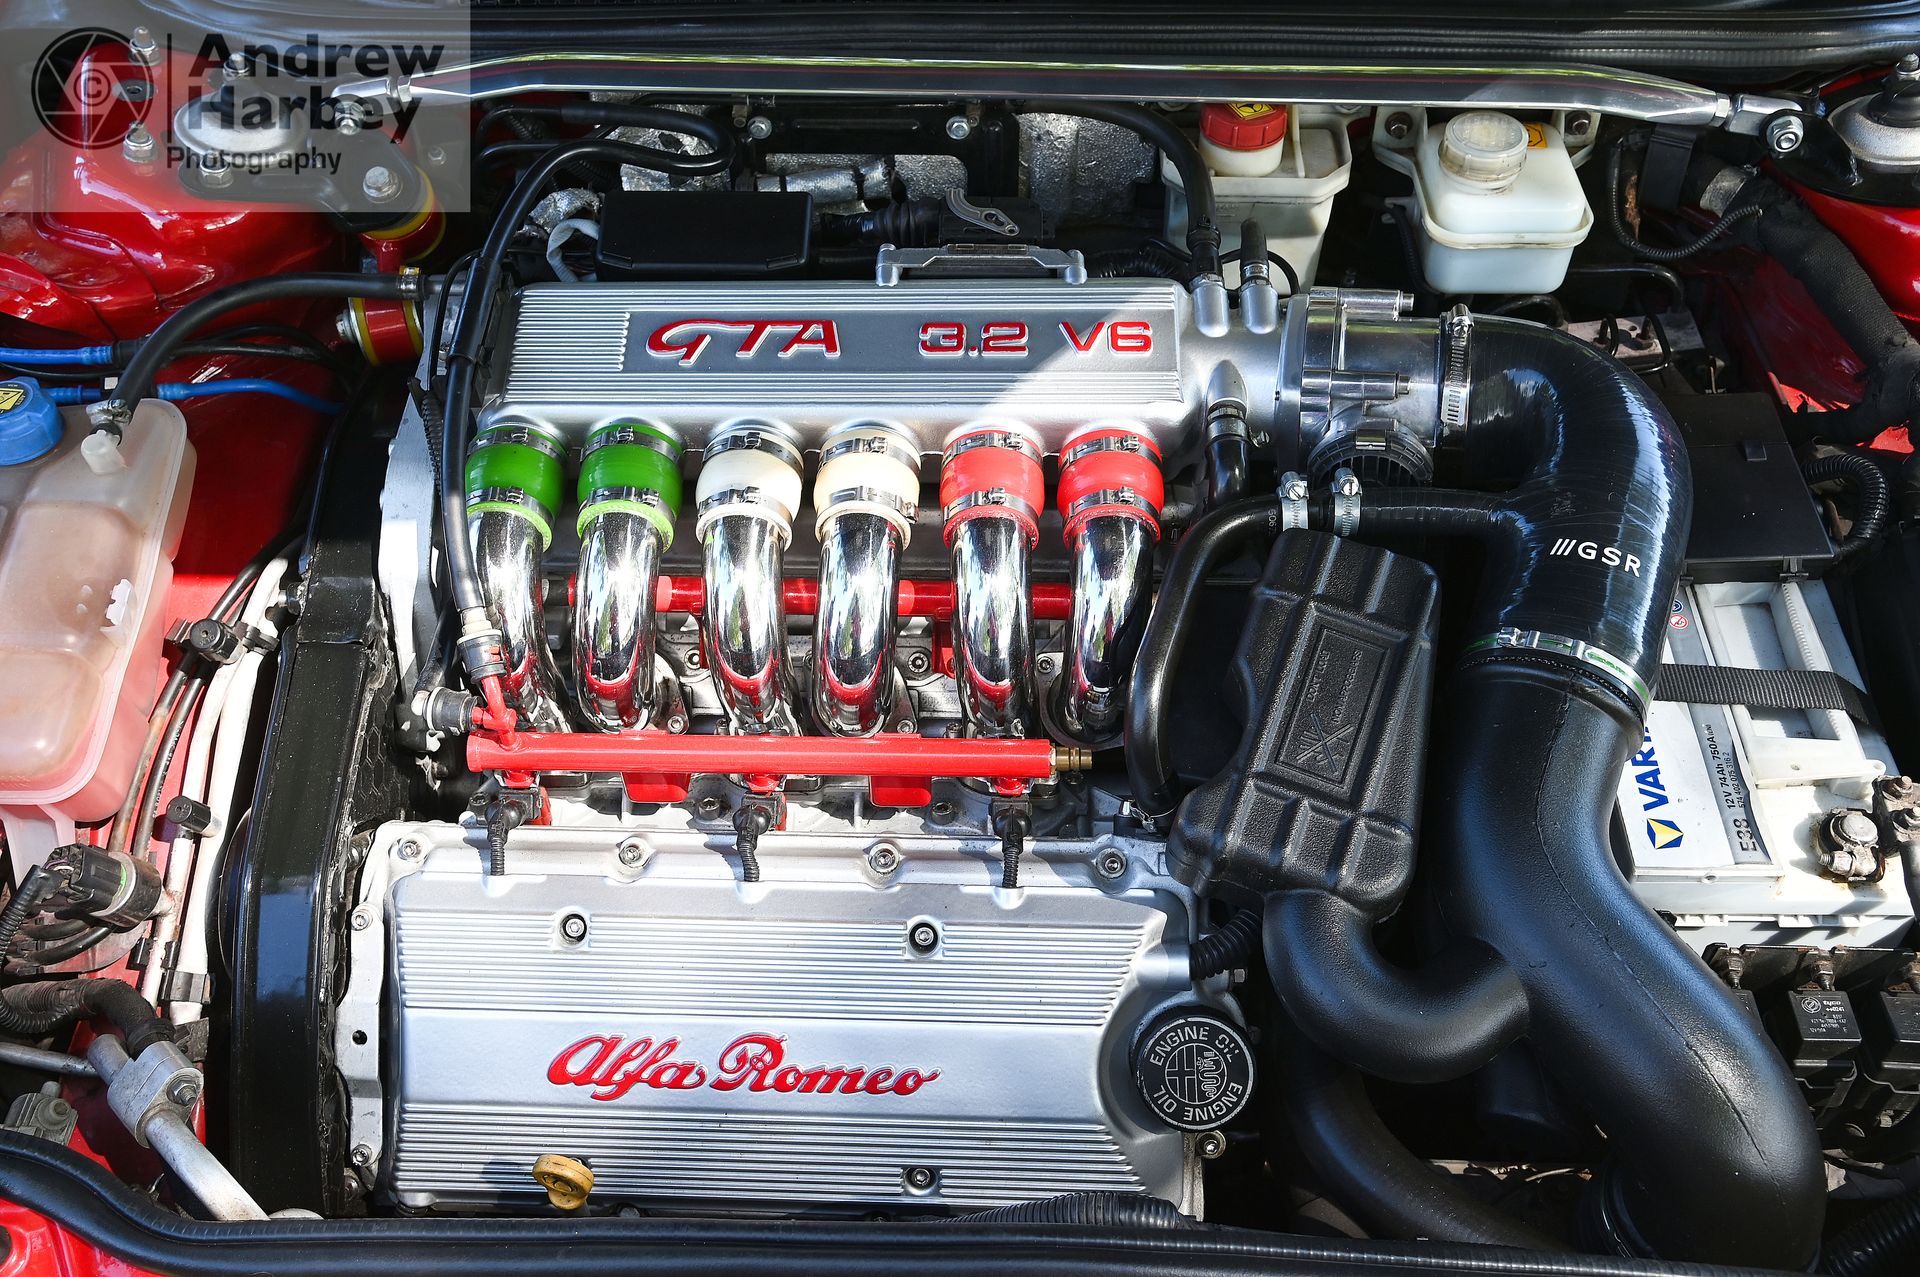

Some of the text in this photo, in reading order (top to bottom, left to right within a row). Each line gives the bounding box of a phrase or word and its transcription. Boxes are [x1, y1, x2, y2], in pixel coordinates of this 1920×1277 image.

[645, 317, 1154, 367] GTA 3.2 V6
[1631, 726, 1669, 812] VAR
[1715, 763, 1729, 789] 74Ah
[1723, 790, 1736, 810] 12V
[1733, 818, 1757, 852] E38
[1150, 1025, 1240, 1066] ENGINE OIL
[546, 1031, 942, 1102] Alfa Romeo
[1153, 1082, 1243, 1122] ENGINE OIL
